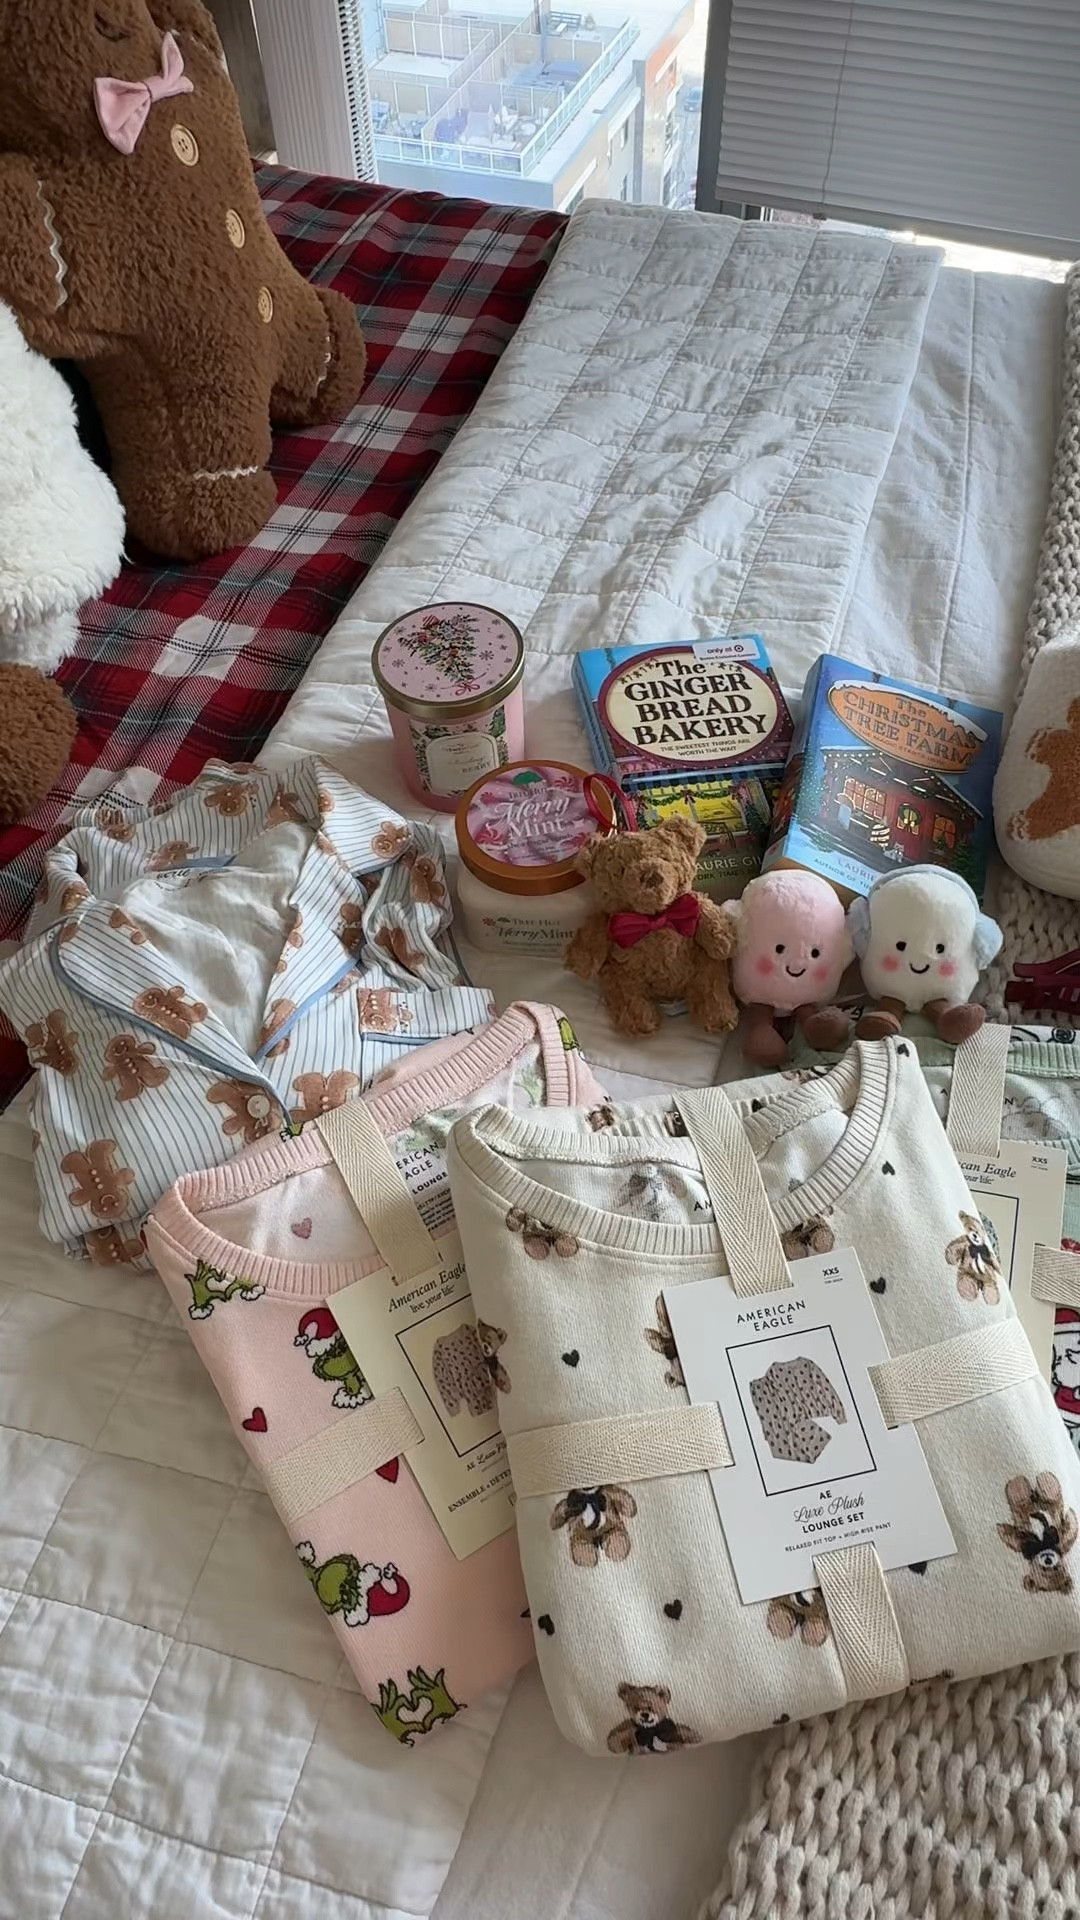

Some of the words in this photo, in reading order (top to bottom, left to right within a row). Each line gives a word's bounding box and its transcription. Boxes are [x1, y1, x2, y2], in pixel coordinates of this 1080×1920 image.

[656, 660, 707, 677] The
[624, 673, 752, 701] GINGER
[635, 694, 752, 722] BREAD
[896, 697, 926, 718] The
[632, 714, 767, 745] BAKERY
[843, 691, 977, 749] CHRISTMAS
[675, 742, 710, 750] SWEETEST
[843, 706, 900, 741] TREE
[906, 732, 971, 764] FARM
[678, 749, 704, 757] WORTH
[486, 797, 570, 827] Merry
[508, 817, 566, 839] Mint
[695, 858, 738, 871] AURIE
[541, 929, 575, 939] Mint
[396, 1142, 440, 1169] ERICAN
[405, 1160, 433, 1180] AGLE
[983, 1162, 1017, 1180] Eagle
[412, 1172, 448, 1195] LOUNGE
[822, 1267, 840, 1277] XXS
[389, 1280, 438, 1312] American
[438, 1262, 466, 1285] Eagle
[737, 1300, 806, 1324] AMERICAN
[753, 1314, 794, 1331] EAGLE
[448, 1486, 486, 1512] ENSEMBLE
[819, 1490, 833, 1500] AE
[793, 1506, 824, 1523] Luxe
[828, 1491, 865, 1515] Plush
[802, 1517, 845, 1534] LOUNGE
[847, 1512, 865, 1523] SET
[785, 1541, 812, 1552] RELAXED
[844, 1530, 859, 1538] HIGH
[861, 1526, 874, 1534] RISE
[875, 1521, 891, 1530] PANT
